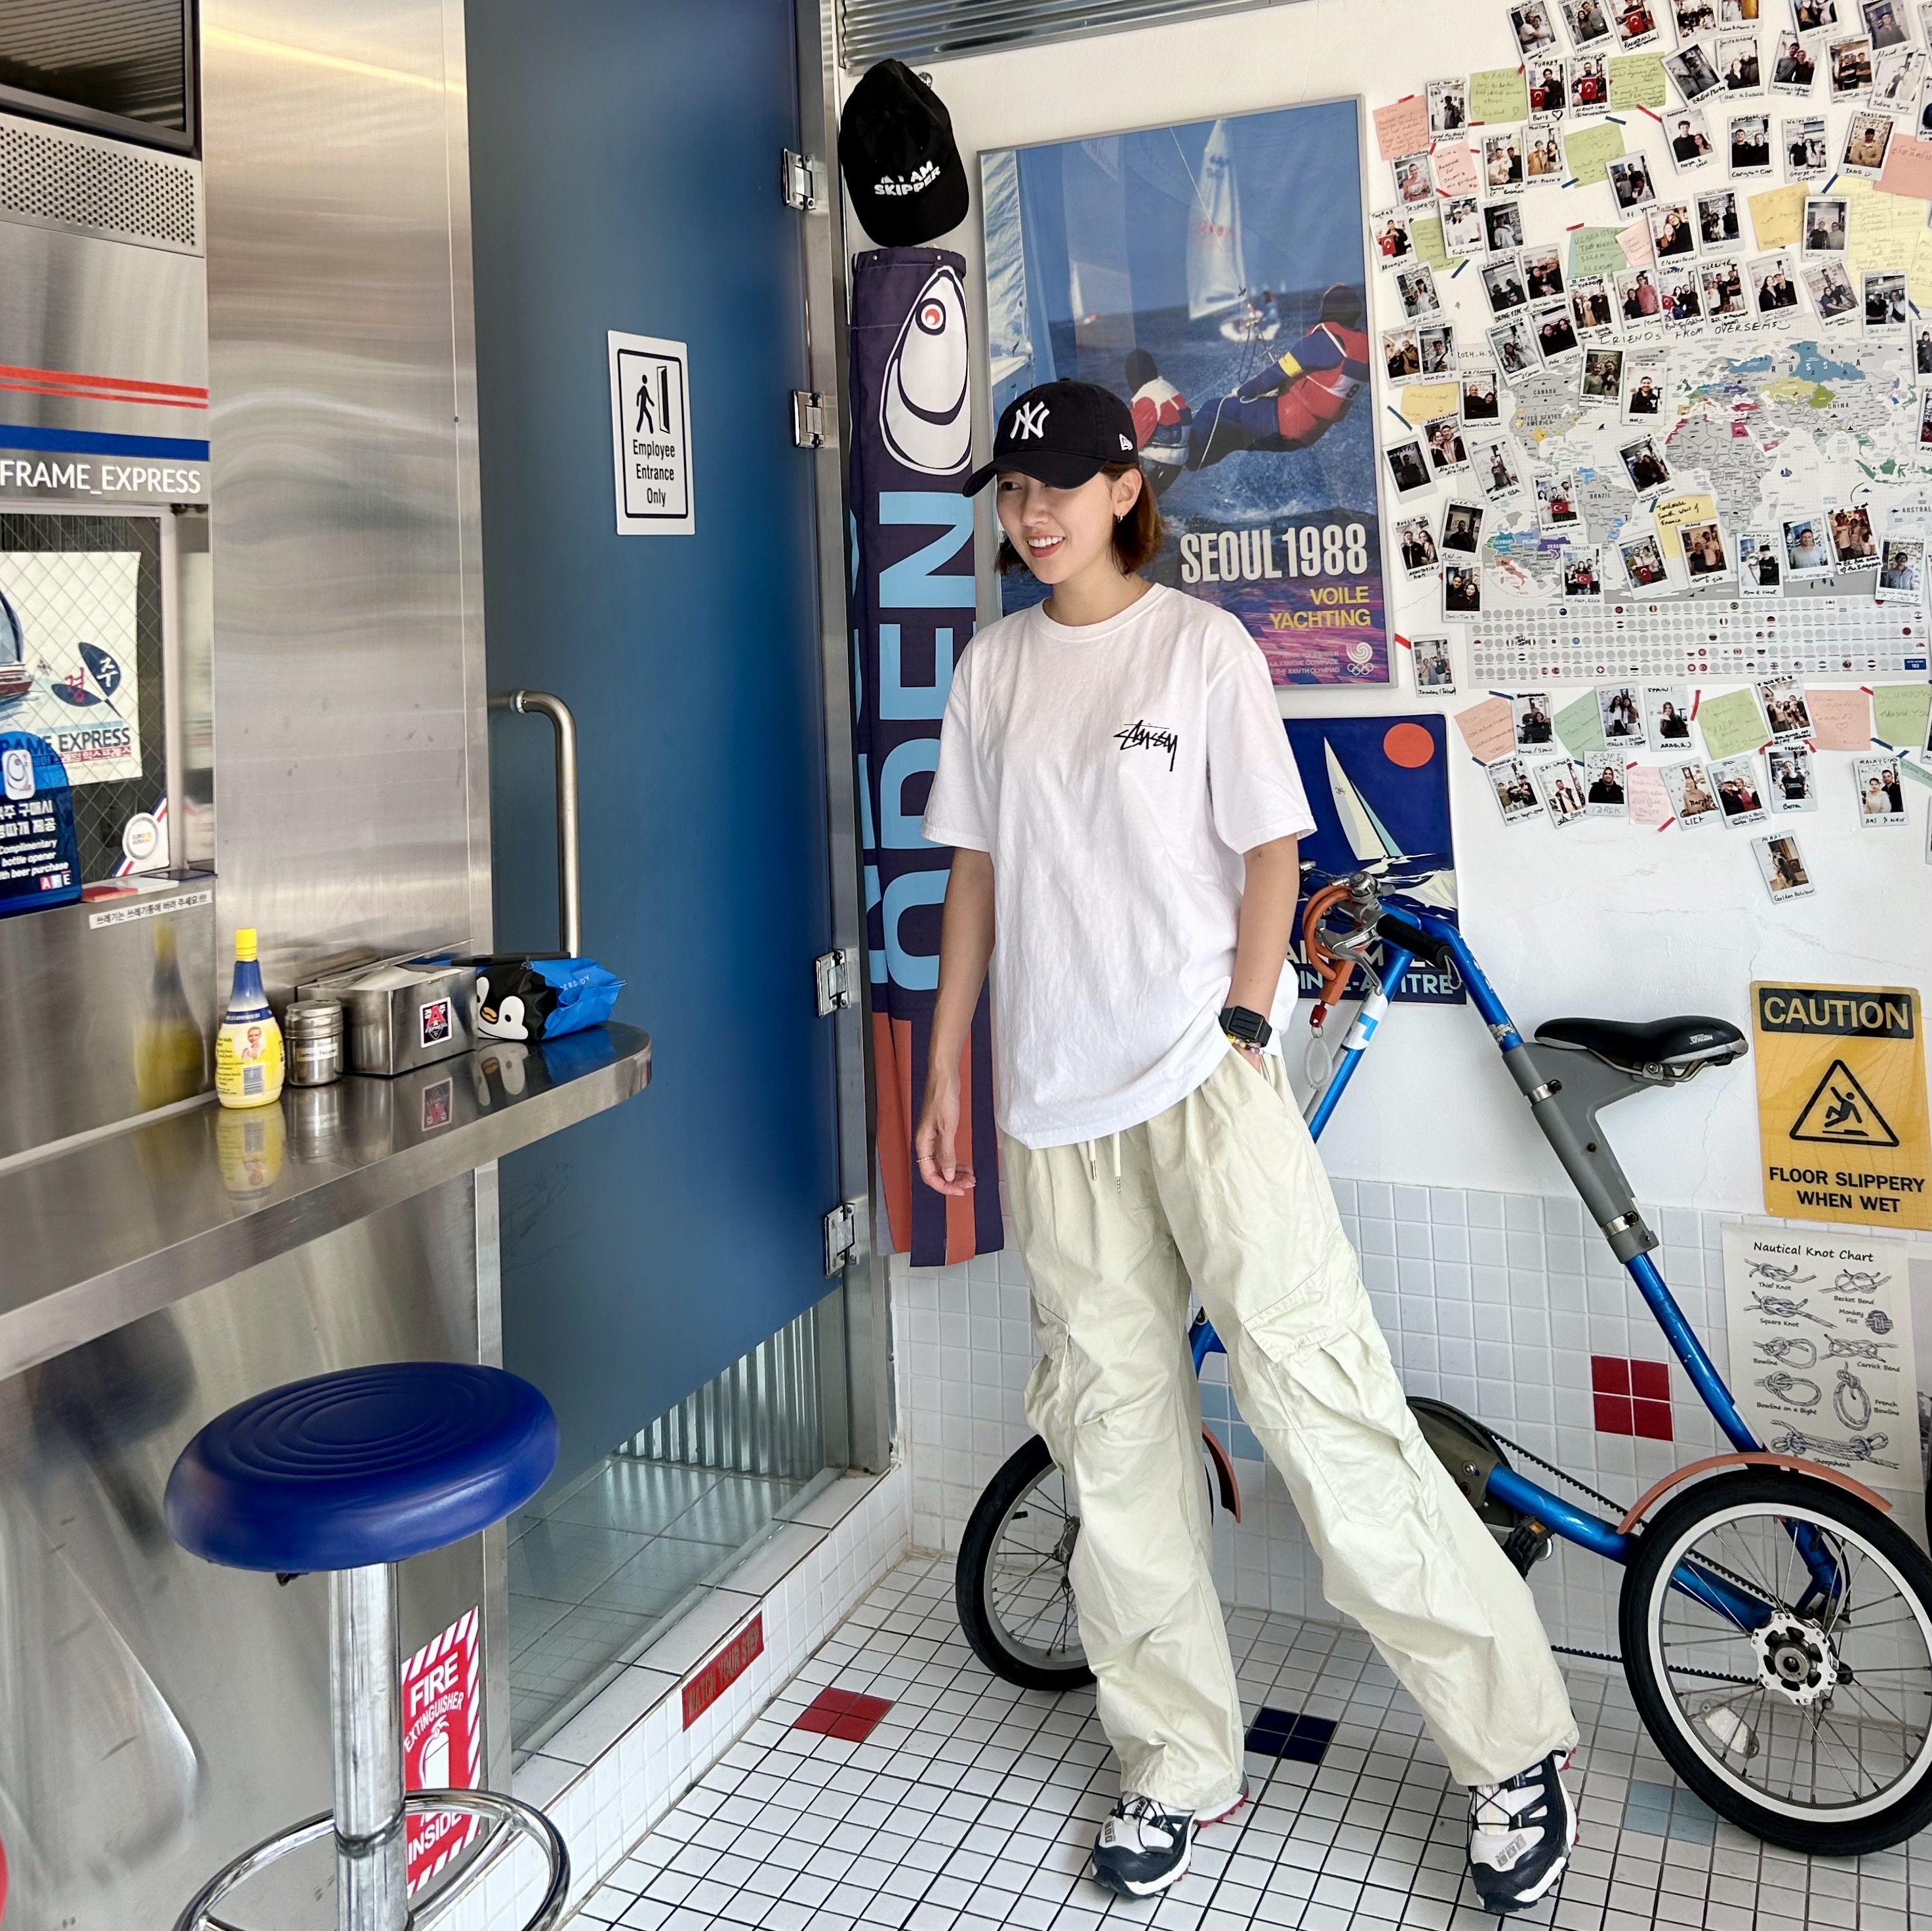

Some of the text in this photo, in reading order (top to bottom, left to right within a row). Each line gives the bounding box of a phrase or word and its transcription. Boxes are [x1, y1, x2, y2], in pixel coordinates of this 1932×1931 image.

[874, 166, 941, 196] SKIPPER
[1010, 401, 1050, 440] NY
[632, 439, 675, 458] Employee
[635, 463, 675, 481] Entrance
[646, 487, 666, 507] Only
[1180, 523, 1368, 584] SEOUL 1988
[1310, 586, 1371, 606] VOILE
[1269, 608, 1372, 629] YACHTING
[59, 727, 132, 752] EXPRESS
[178, 896, 198, 907] 주세요
[1763, 997, 1909, 1030] CAUTION
[1769, 1166, 1925, 1193] FLOOR SLIPPERY
[1796, 1190, 1901, 1212] WHEN WET
[1753, 1242, 1874, 1263] Nautical Knot Chart
[1758, 1281, 1775, 1290] Thief
[1834, 1295, 1856, 1304] Becket
[1760, 1317, 1800, 1328] Square Knot
[1838, 1308, 1864, 1319] Monkey
[1857, 1361, 1901, 1372] Carrick Bend
[1756, 1402, 1782, 1411] Bowline
[1800, 1406, 1818, 1416] Bight
[1874, 1406, 1900, 1416] Bowline
[1875, 1399, 1898, 1407] French
[1813, 1457, 1851, 1469] Sheepshank
[741, 1623, 759, 1664] STEP
[410, 1651, 460, 1718] FIRE
[403, 1690, 464, 1753] EXTINGUISHER
[407, 1813, 463, 1865] INSIDE
